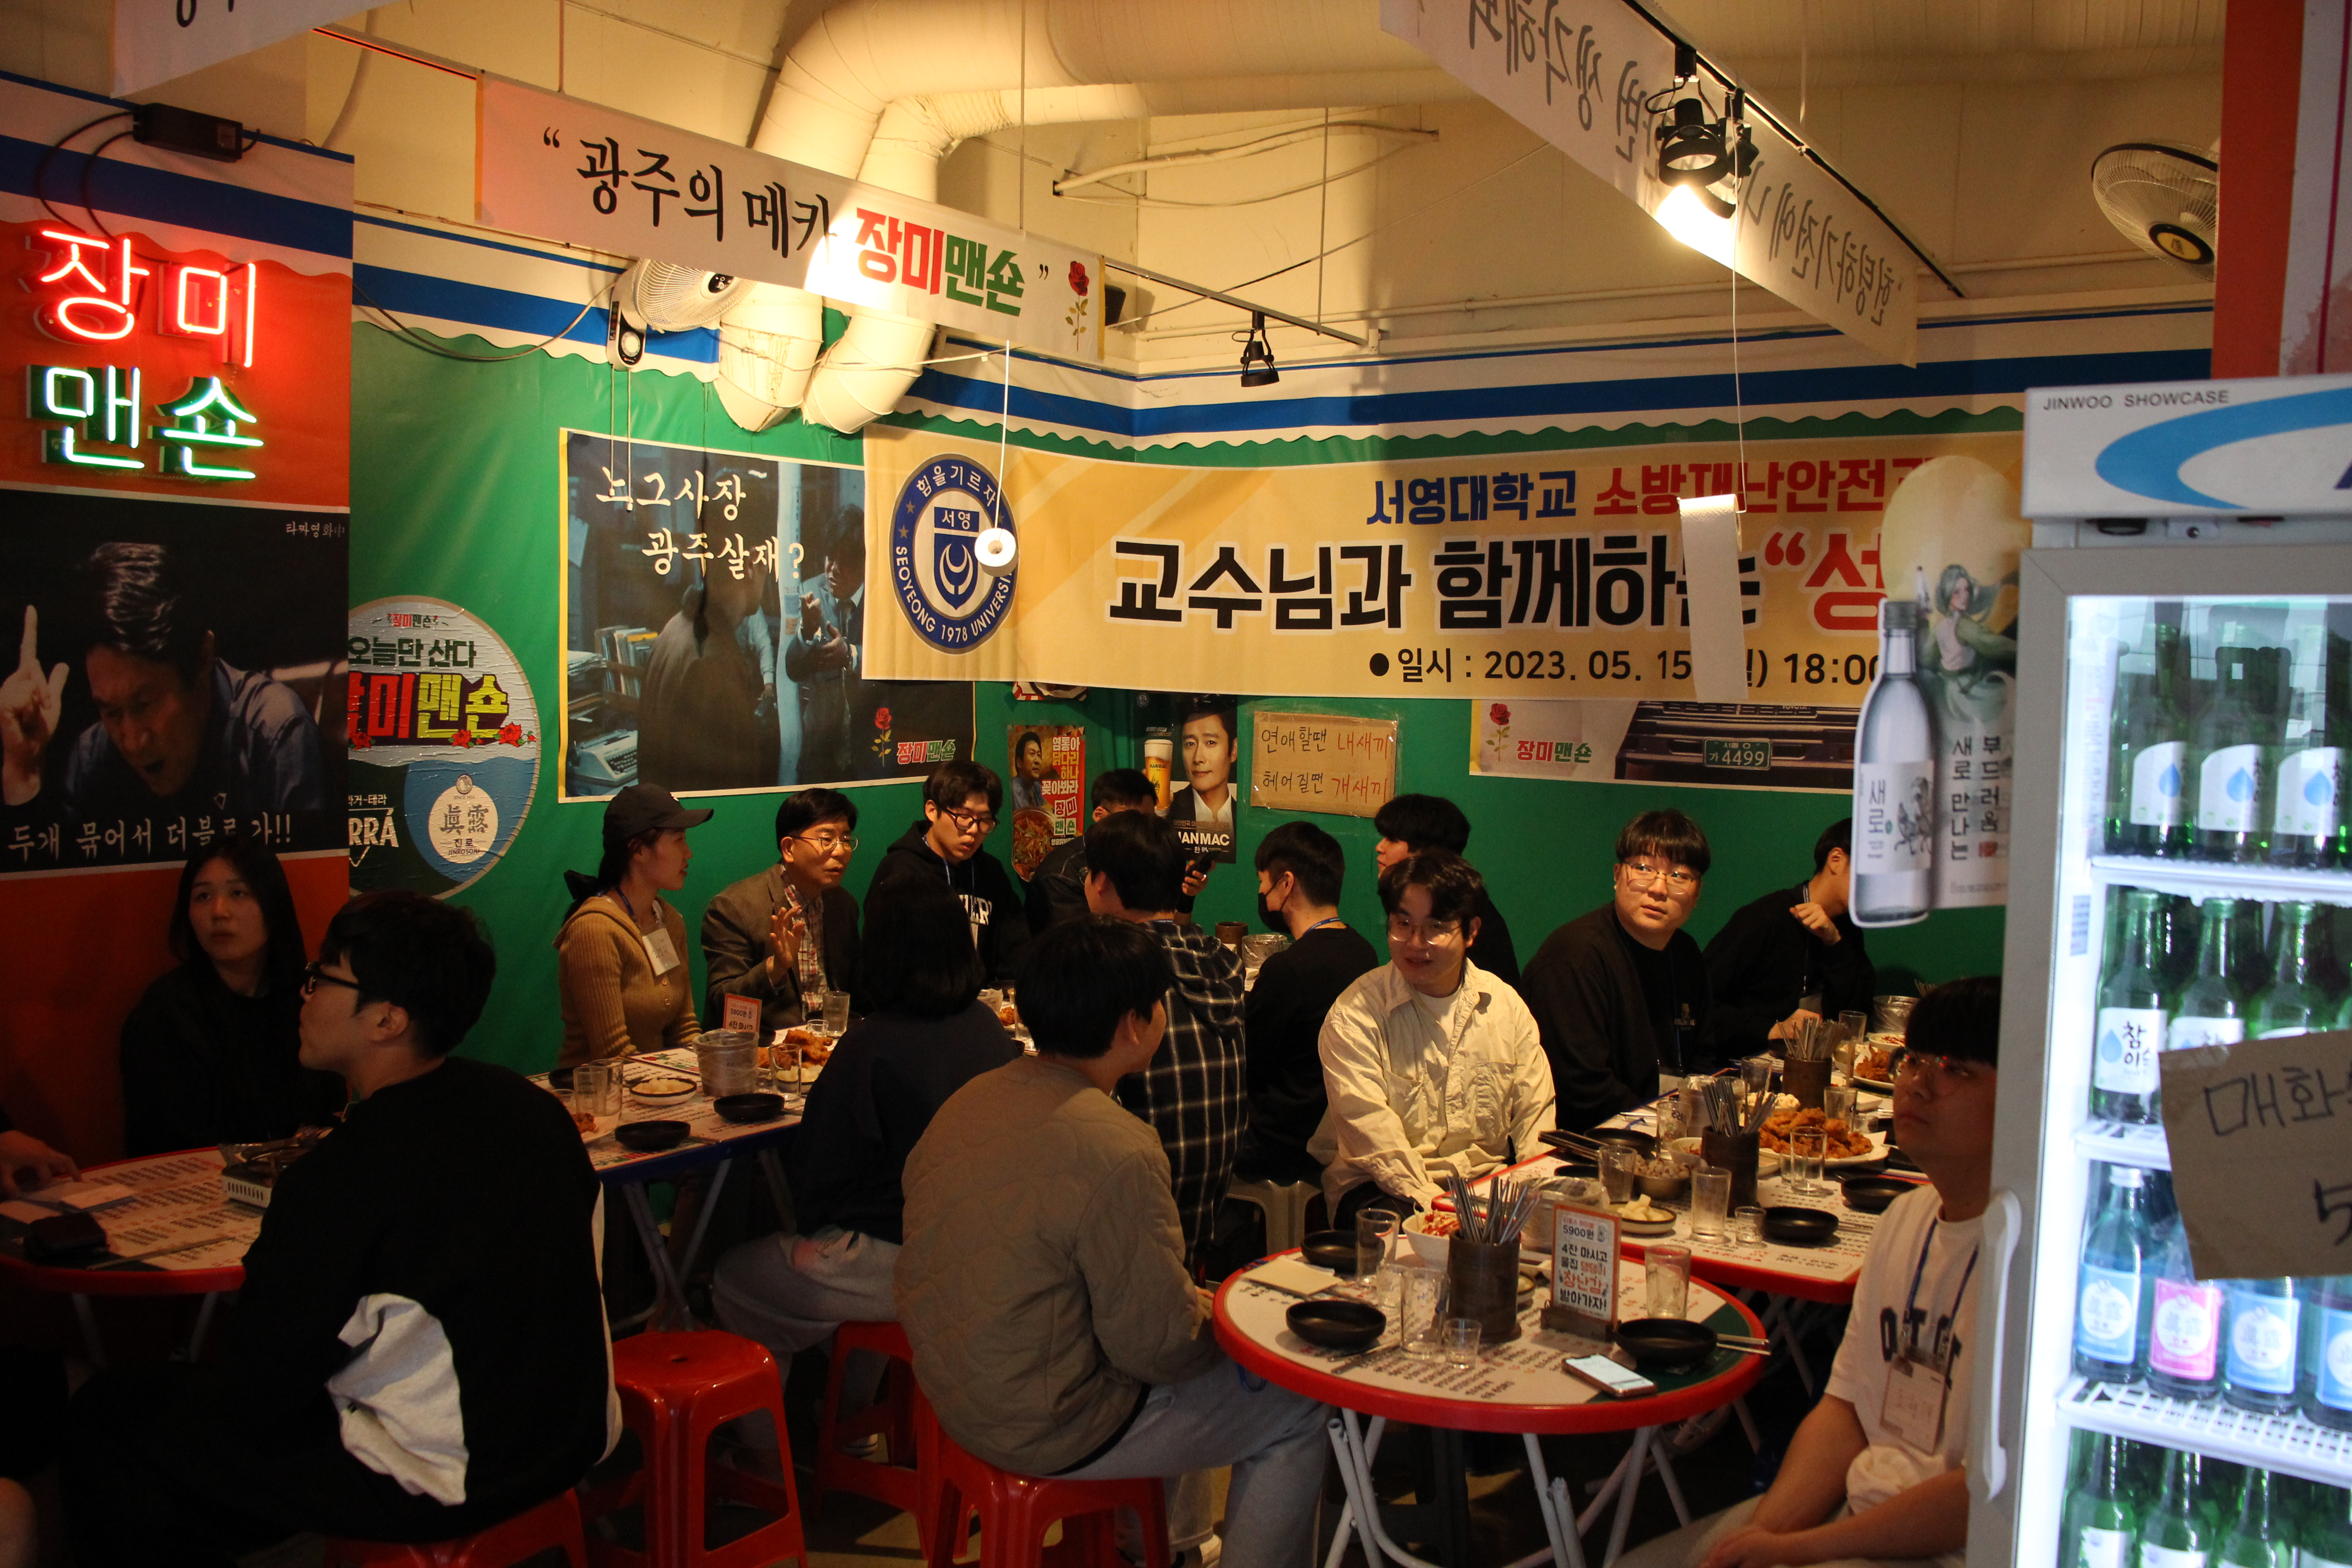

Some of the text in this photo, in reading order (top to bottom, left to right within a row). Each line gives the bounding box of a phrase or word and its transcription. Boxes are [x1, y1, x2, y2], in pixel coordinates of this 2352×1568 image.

[742, 181, 837, 265] 메카
[41, 230, 257, 368] 장미
[2043, 390, 2230, 411] JINWOO SHOWCASE
[44, 365, 265, 480] 맨숀
[1367, 470, 1576, 524] 서영대학교
[942, 510, 971, 529] 서영
[897, 546, 1012, 643] SEOYEONG 1978 UNIVERSI
[1109, 541, 1411, 630] 교수님과
[393, 614, 431, 628] 장미맨숀
[348, 637, 476, 668] 오늘만 산다
[1398, 648, 1452, 683] 일시
[1485, 650, 1575, 681] 2023.
[1589, 650, 1641, 681] 05.
[897, 739, 956, 764] 장미맨숀
[1053, 736, 1080, 751] 염통아
[1262, 726, 1388, 760] 연애할땐 내새끼
[1516, 739, 1592, 764] 장미맨숀
[1722, 750, 1764, 766] 4499
[1953, 735, 1972, 780] 새로
[1061, 766, 1079, 779] 하나
[1263, 771, 1387, 803] 헤어질땐 개새끼
[1981, 735, 2001, 833] 부드러움
[1055, 799, 1076, 816] 장미
[1868, 779, 1886, 833] 새로
[8, 821, 59, 862] 두개
[76, 819, 152, 858] 묶어서
[251, 812, 291, 845] 가!!
[1055, 820, 1075, 834] 맨숀
[1951, 793, 1970, 860] 만나는
[454, 838, 474, 848] 진로
[2204, 1067, 2352, 1136] 매화
[1563, 1225, 1594, 1240] 5900원
[1562, 1244, 1607, 1262] 4잔 마시고
[1563, 1270, 1602, 1295] 장난감
[1560, 1288, 1607, 1311] 받아가자!
